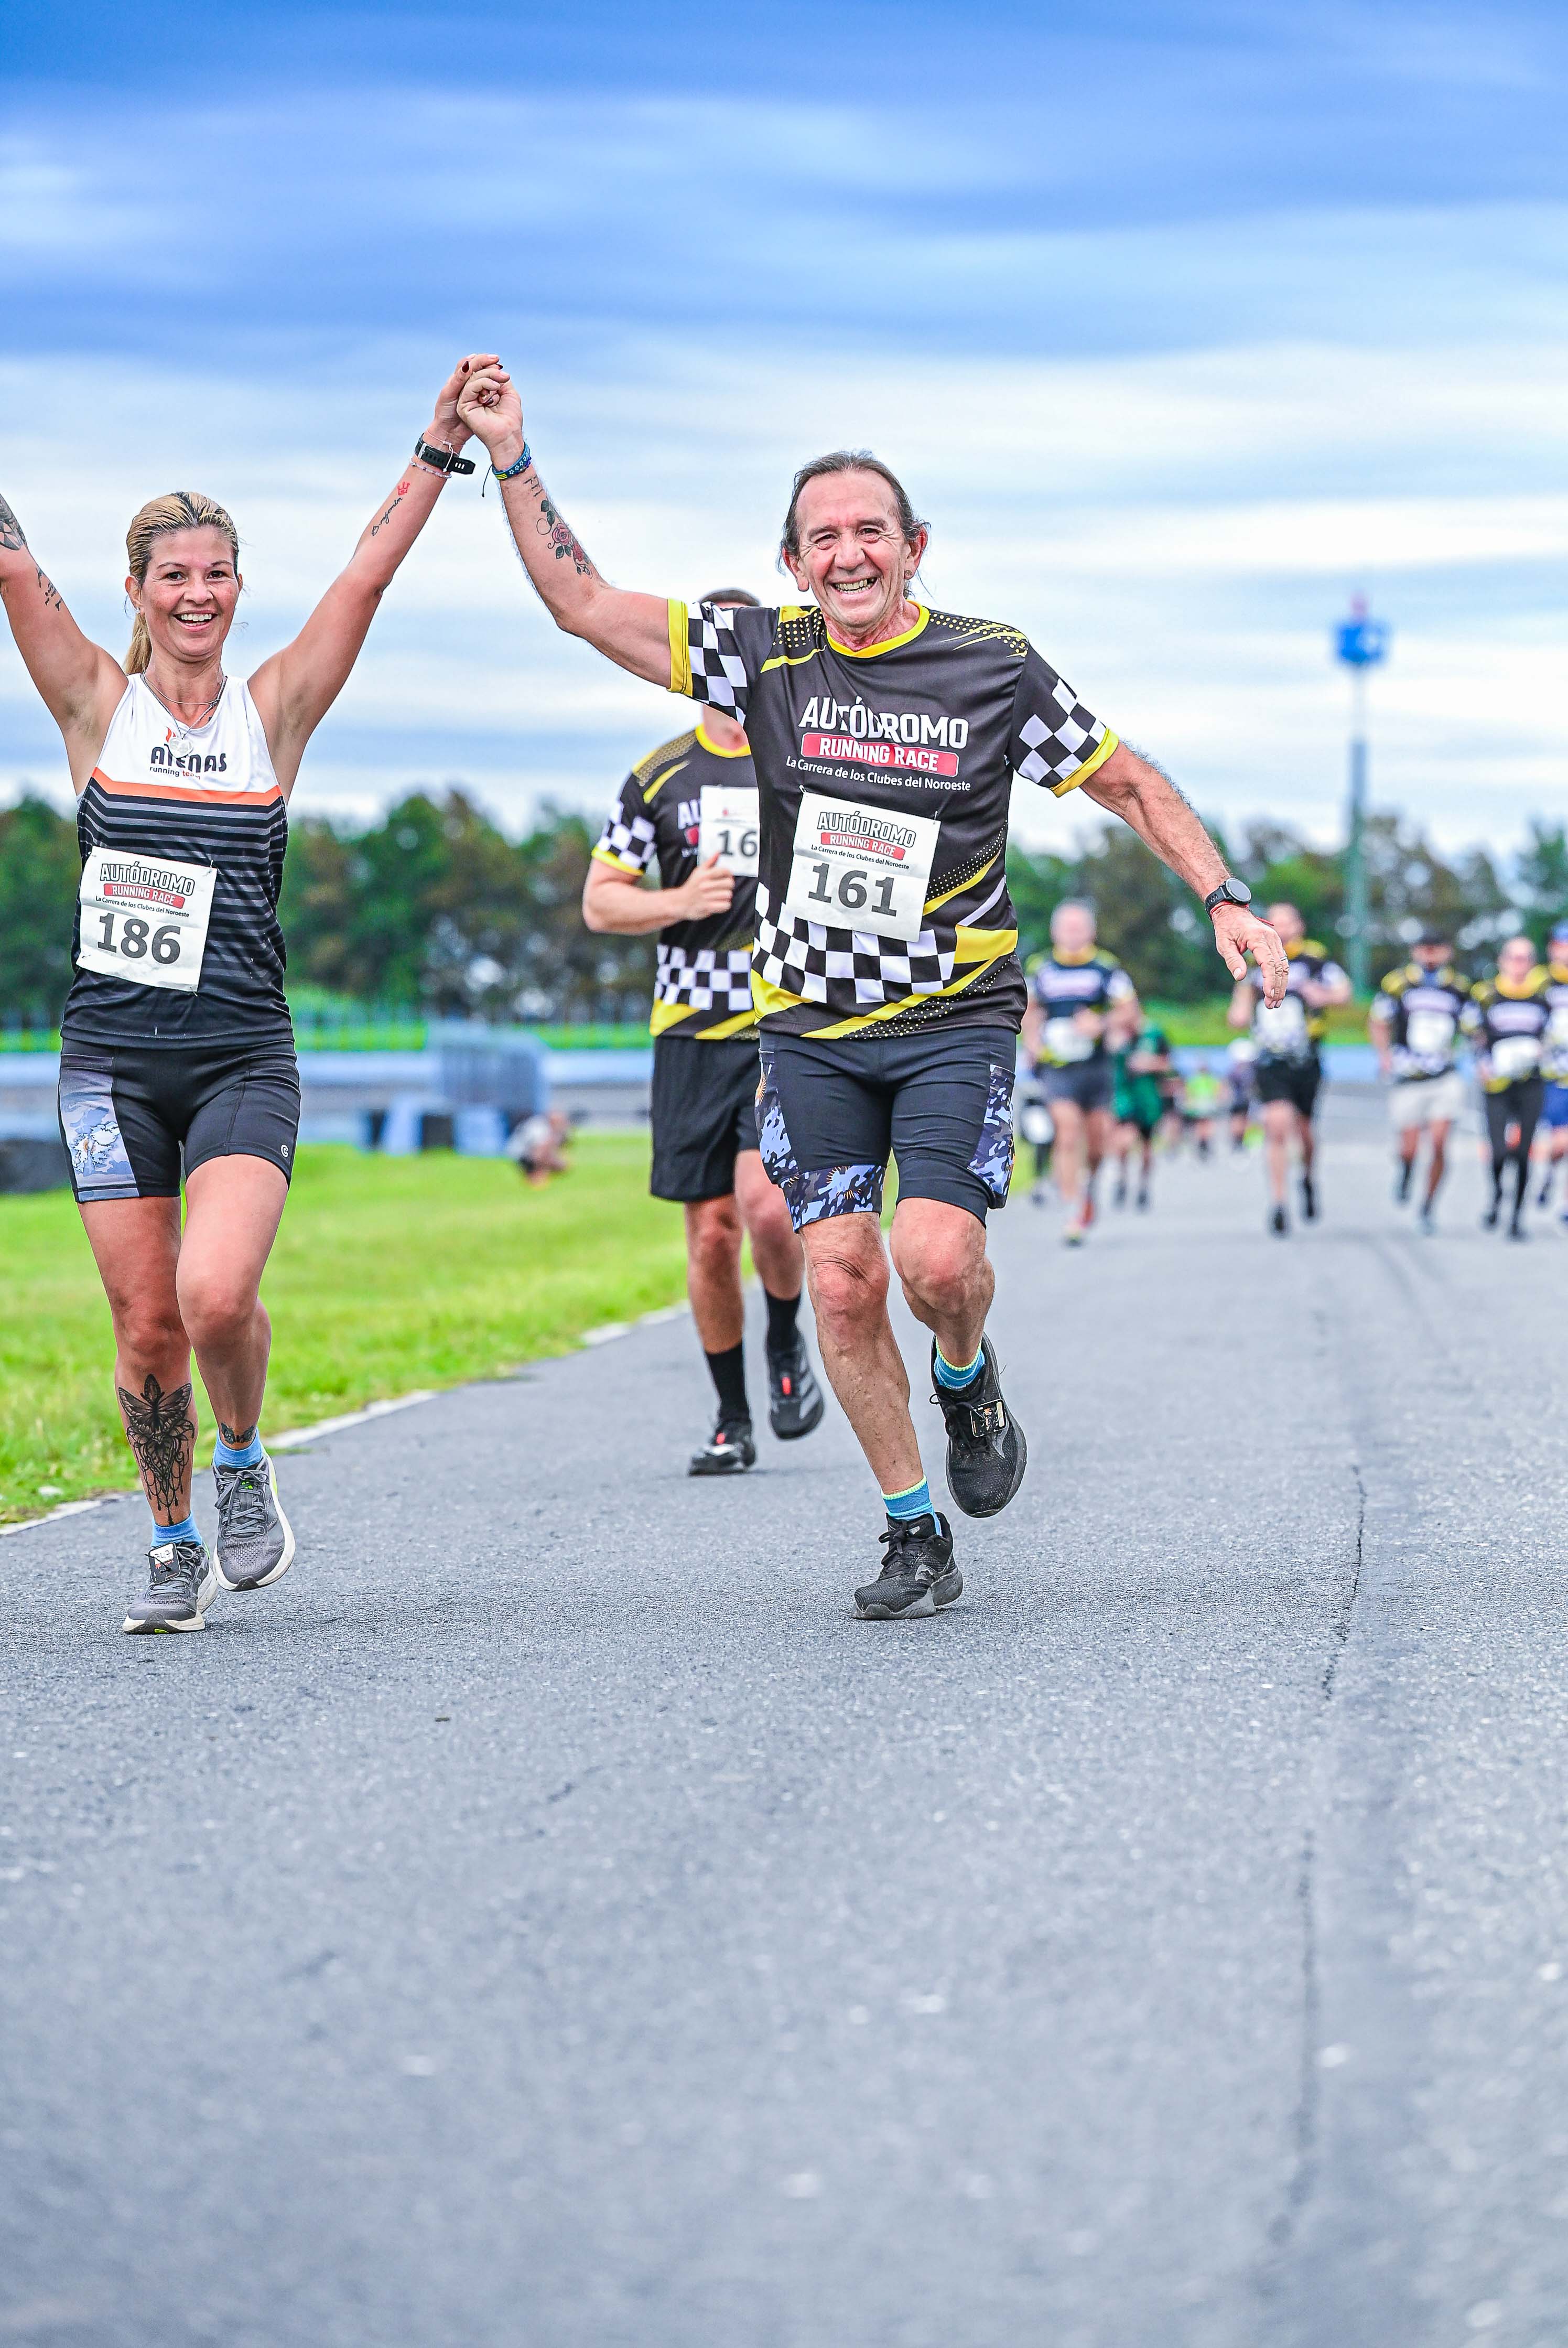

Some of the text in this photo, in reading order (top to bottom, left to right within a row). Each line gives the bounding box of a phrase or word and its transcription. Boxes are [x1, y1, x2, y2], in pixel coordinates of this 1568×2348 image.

[798, 696, 969, 749] AUTÓDROMO
[819, 737, 940, 771] RUNNING RACE
[149, 766, 180, 777] running
[786, 756, 971, 791] La Carrera de los Clubes del Noroeste
[817, 811, 916, 848] AUTÓDROMO
[830, 834, 896, 857] RUNNING RACE
[818, 846, 838, 855] Carrera
[856, 854, 874, 863] Clubes
[885, 860, 910, 870] Noroeste
[100, 861, 195, 896] AUTÓDROMO
[112, 885, 176, 906] RUNNING RACE
[808, 863, 897, 917] 161
[102, 897, 120, 906] Carrera
[166, 909, 190, 918] Noroeste
[98, 912, 181, 964] 186
